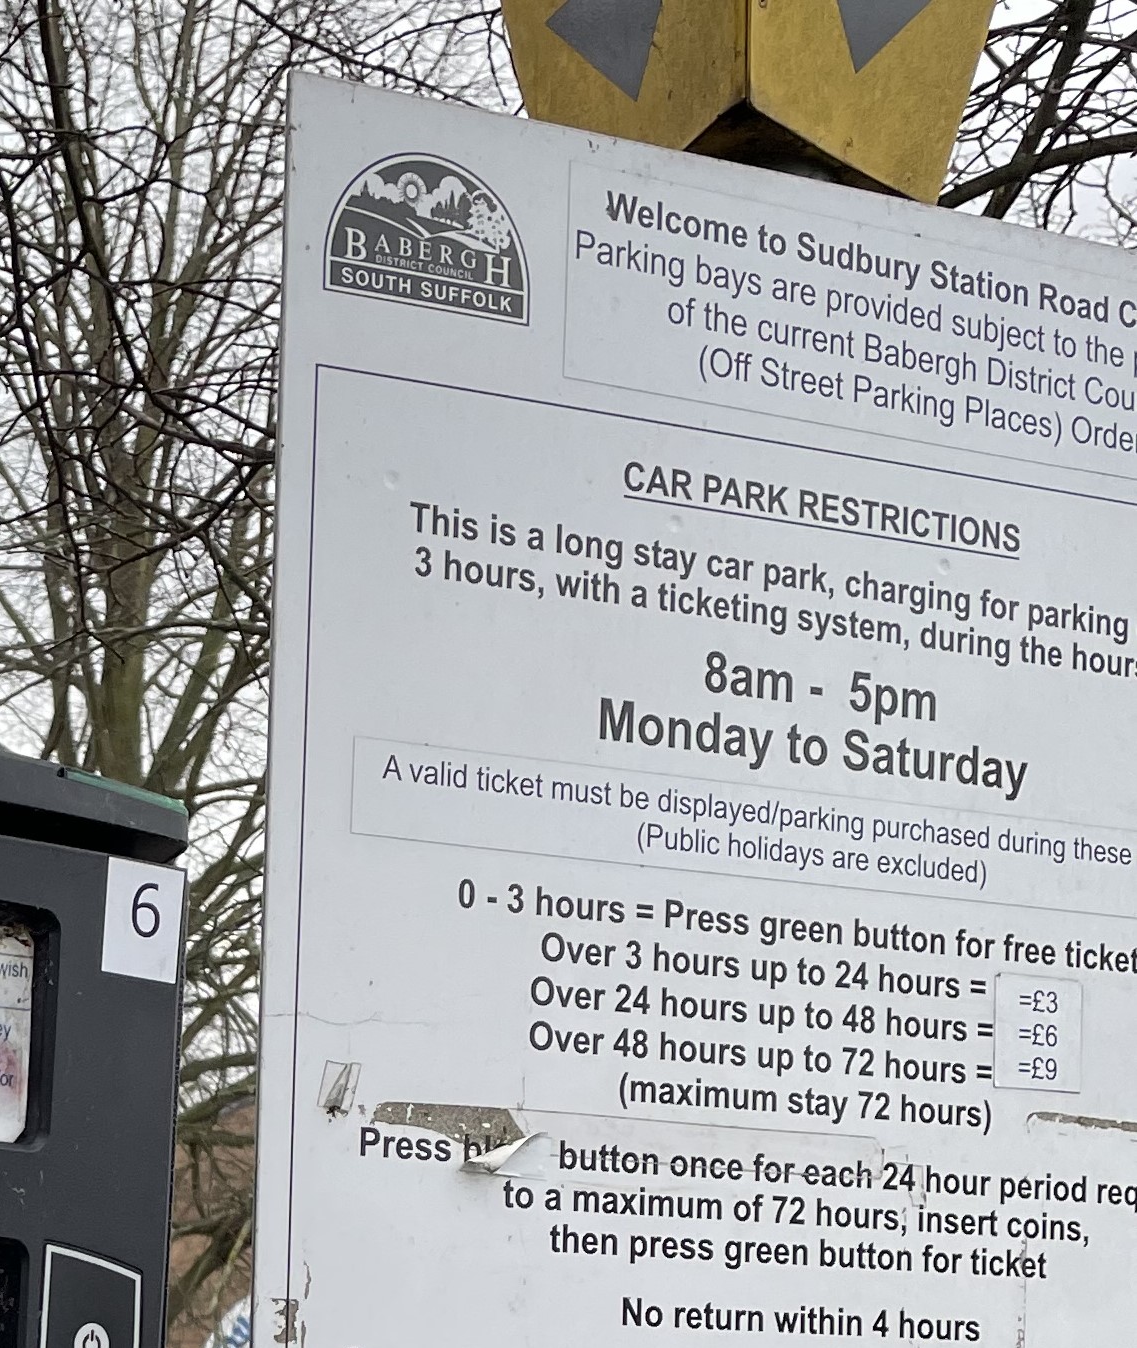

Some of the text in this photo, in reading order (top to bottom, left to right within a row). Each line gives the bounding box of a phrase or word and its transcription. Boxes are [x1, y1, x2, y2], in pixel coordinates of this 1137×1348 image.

[344, 227, 511, 288] BABERGH
[375, 254, 474, 281] DISTRICT COUNCIL
[605, 190, 748, 248] Welcome
[757, 224, 787, 256] to
[796, 231, 921, 291] Sudbury
[930, 260, 1028, 308] Station
[1039, 282, 1109, 324] Road
[341, 266, 512, 312] SOUTH SUFFOLK
[622, 461, 1022, 553] CAR PARK RESTRICTIONS
[704, 650, 793, 703] 8am
[849, 670, 936, 726] 5pm
[599, 697, 1028, 802] Monday to Saturday
[637, 821, 987, 891] (Public holidays are excluded)
[131, 882, 161, 938] 6
[458, 878, 475, 909] 0
[507, 883, 524, 914] 3
[536, 885, 626, 924] hours
[664, 898, 750, 936] Press
[760, 916, 843, 946] green
[853, 918, 946, 955] button
[955, 928, 996, 960] for
[1003, 933, 1056, 966] free
[1018, 990, 1060, 1015] =£3
[1018, 1024, 1059, 1049] =£6
[1017, 1058, 1059, 1082] =£9
[619, 1071, 992, 1136] (maximum stay 72 hours)
[622, 1296, 980, 1342] No return within 4 hours
